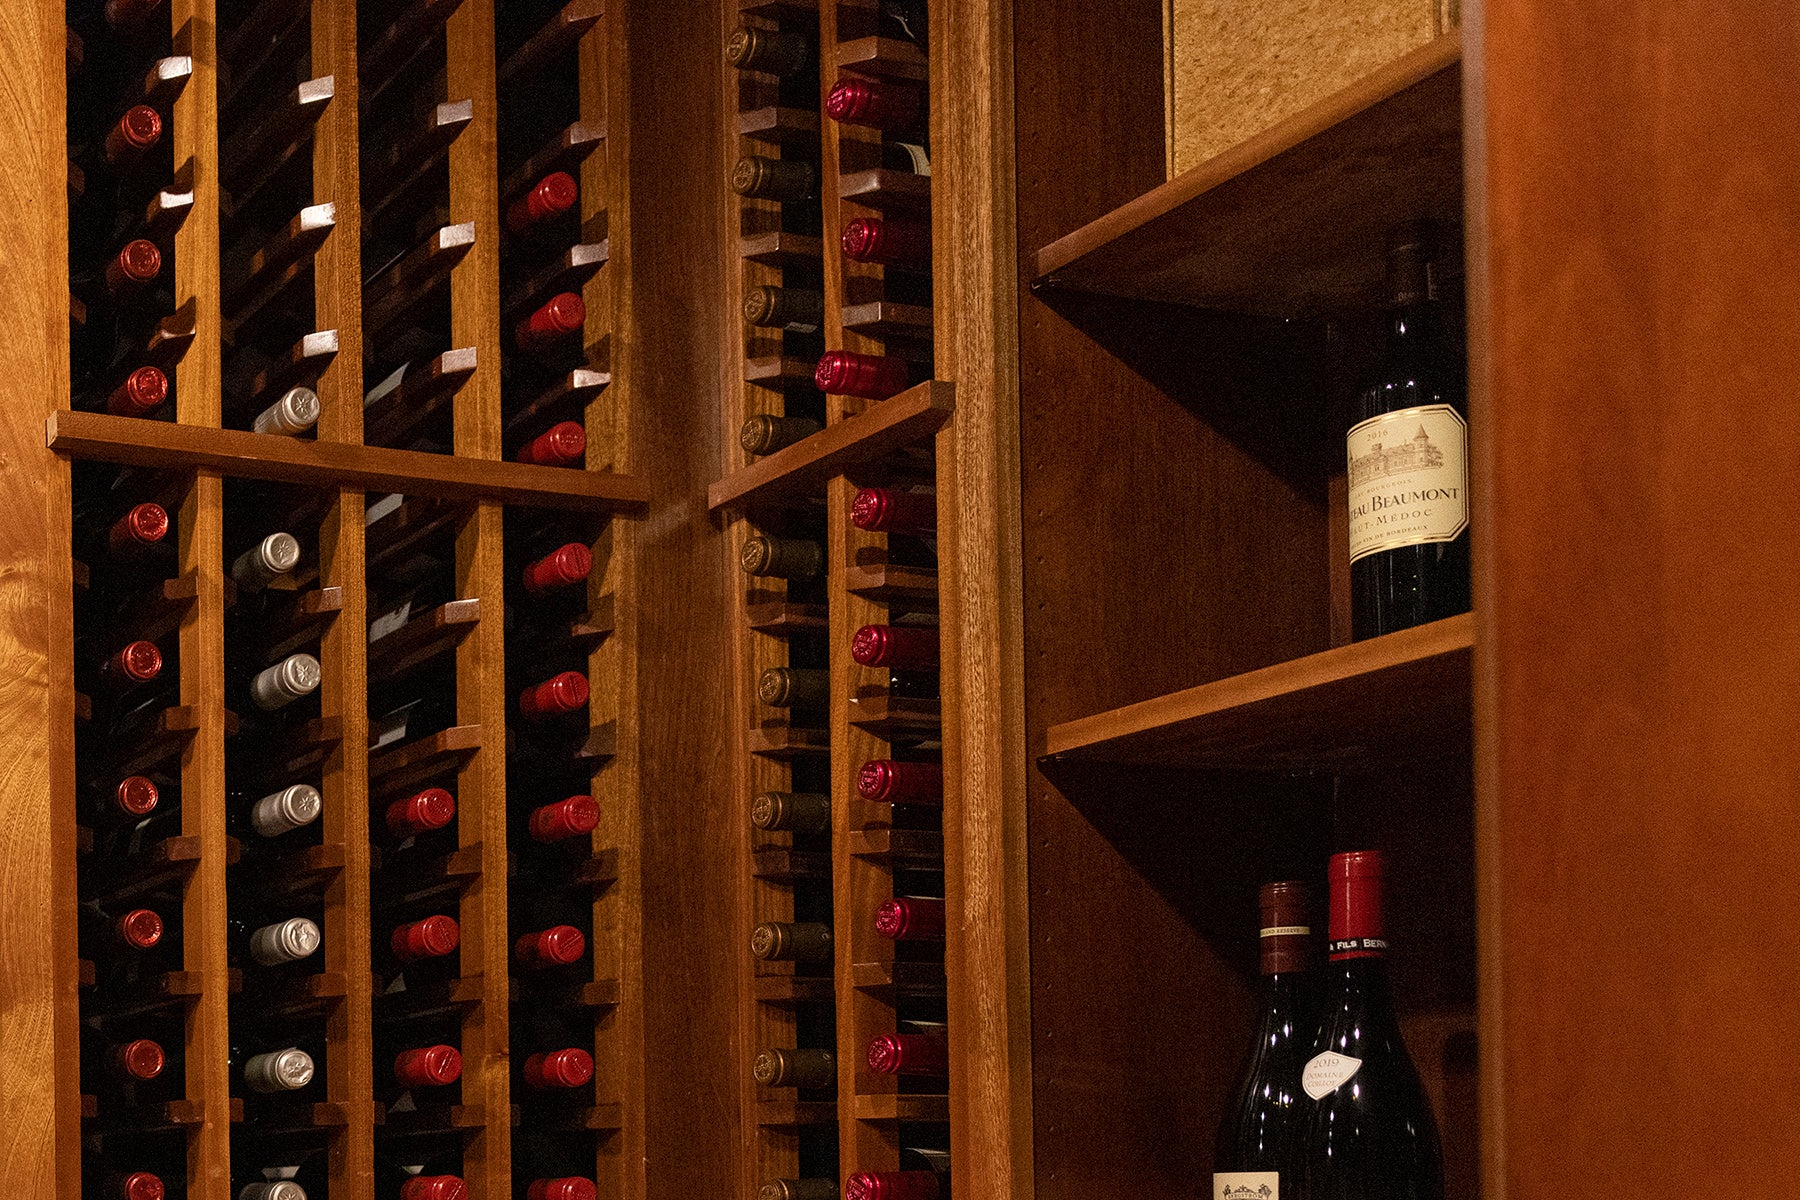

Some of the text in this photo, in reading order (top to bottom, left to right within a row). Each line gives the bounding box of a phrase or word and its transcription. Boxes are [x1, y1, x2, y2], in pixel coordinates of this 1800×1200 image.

[1372, 487, 1460, 512] BEAUMONT
[1336, 939, 1358, 950] FILS
[1313, 1058, 1340, 1069] 2019
